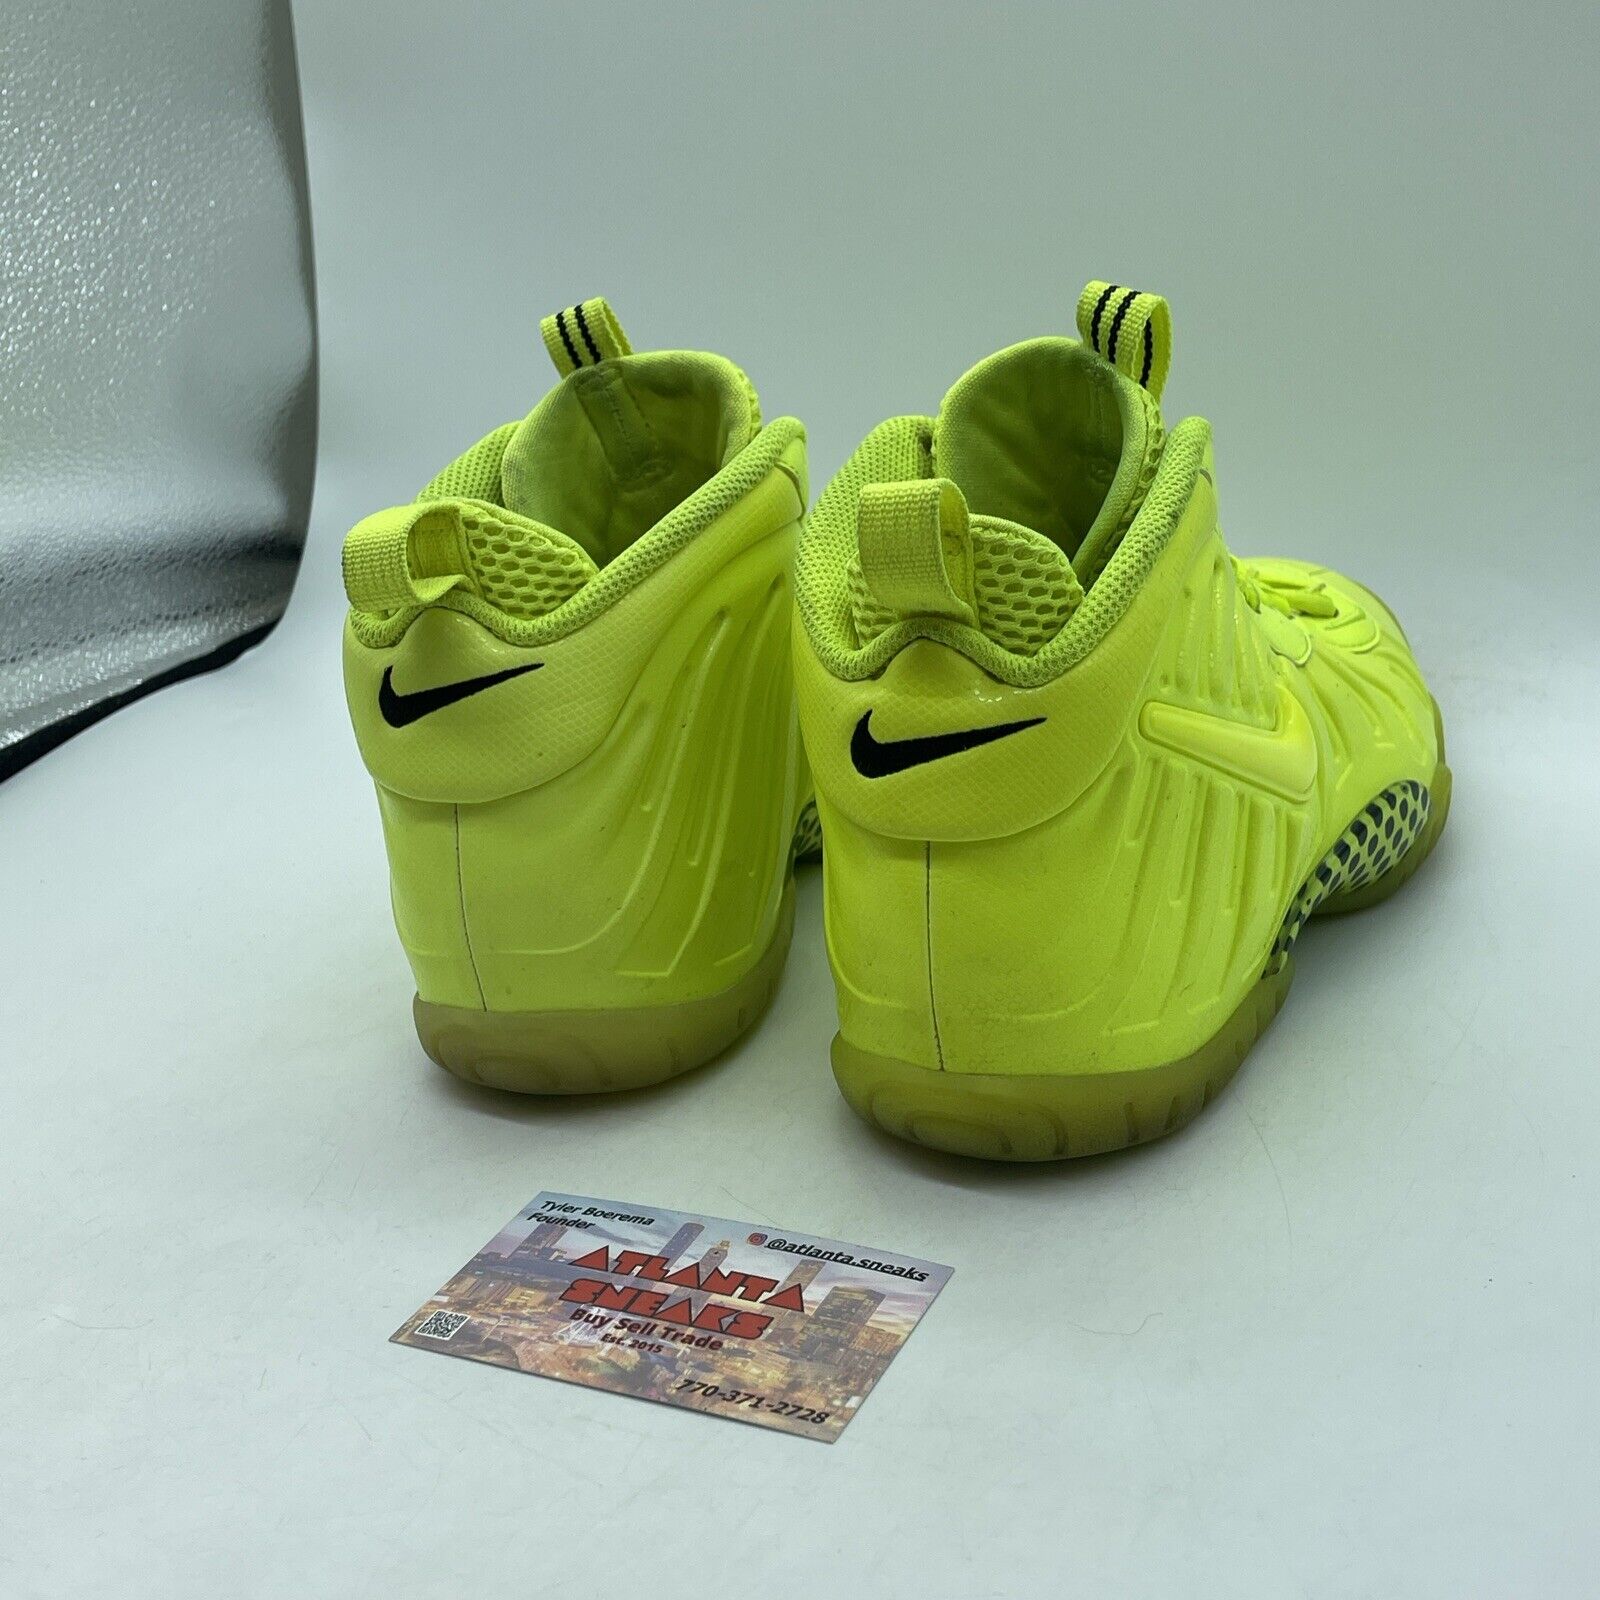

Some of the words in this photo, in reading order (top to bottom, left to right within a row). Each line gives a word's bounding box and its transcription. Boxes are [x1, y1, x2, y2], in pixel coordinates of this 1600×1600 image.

[526, 1212, 596, 1230] Founder
[541, 1200, 583, 1215] Tyler
[582, 1207, 656, 1226] Boerema
[567, 1245, 804, 1312] ATLANTA
[765, 1238, 930, 1282] @atlanta.sneaks
[558, 1278, 774, 1340] SNEAKS
[569, 1308, 614, 1329] Buy
[614, 1317, 658, 1336] Sell
[662, 1326, 724, 1350] Trade
[601, 1333, 625, 1346] Est.
[627, 1339, 665, 1353] 2015
[675, 1378, 830, 1424] 770-371-2728
